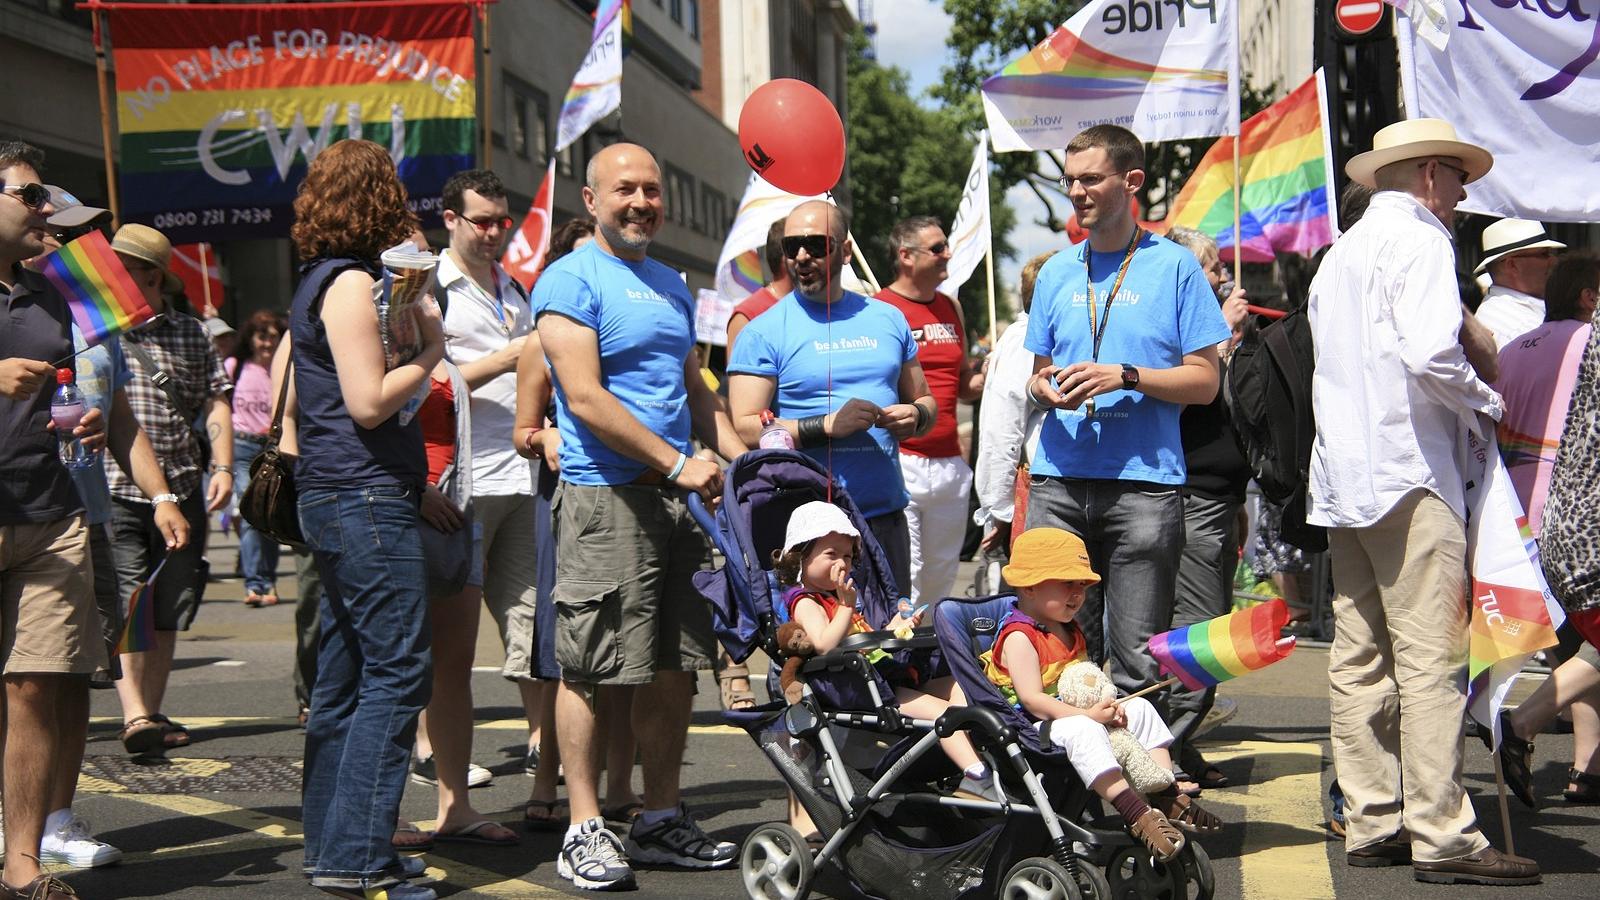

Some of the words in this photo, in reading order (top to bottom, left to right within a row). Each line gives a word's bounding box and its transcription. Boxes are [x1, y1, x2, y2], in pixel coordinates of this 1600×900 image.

[126, 75, 171, 122] NO
[273, 28, 328, 60] FOR
[336, 31, 466, 102] PREJUDICE
[154, 211, 198, 229] 0800
[202, 208, 225, 226] 731
[231, 207, 272, 225] 7434
[923, 323, 959, 341] DIESEL
[814, 340, 830, 350] be
[840, 335, 877, 350] family
[1520, 337, 1541, 349] TUC
[1479, 589, 1504, 627] TUC
